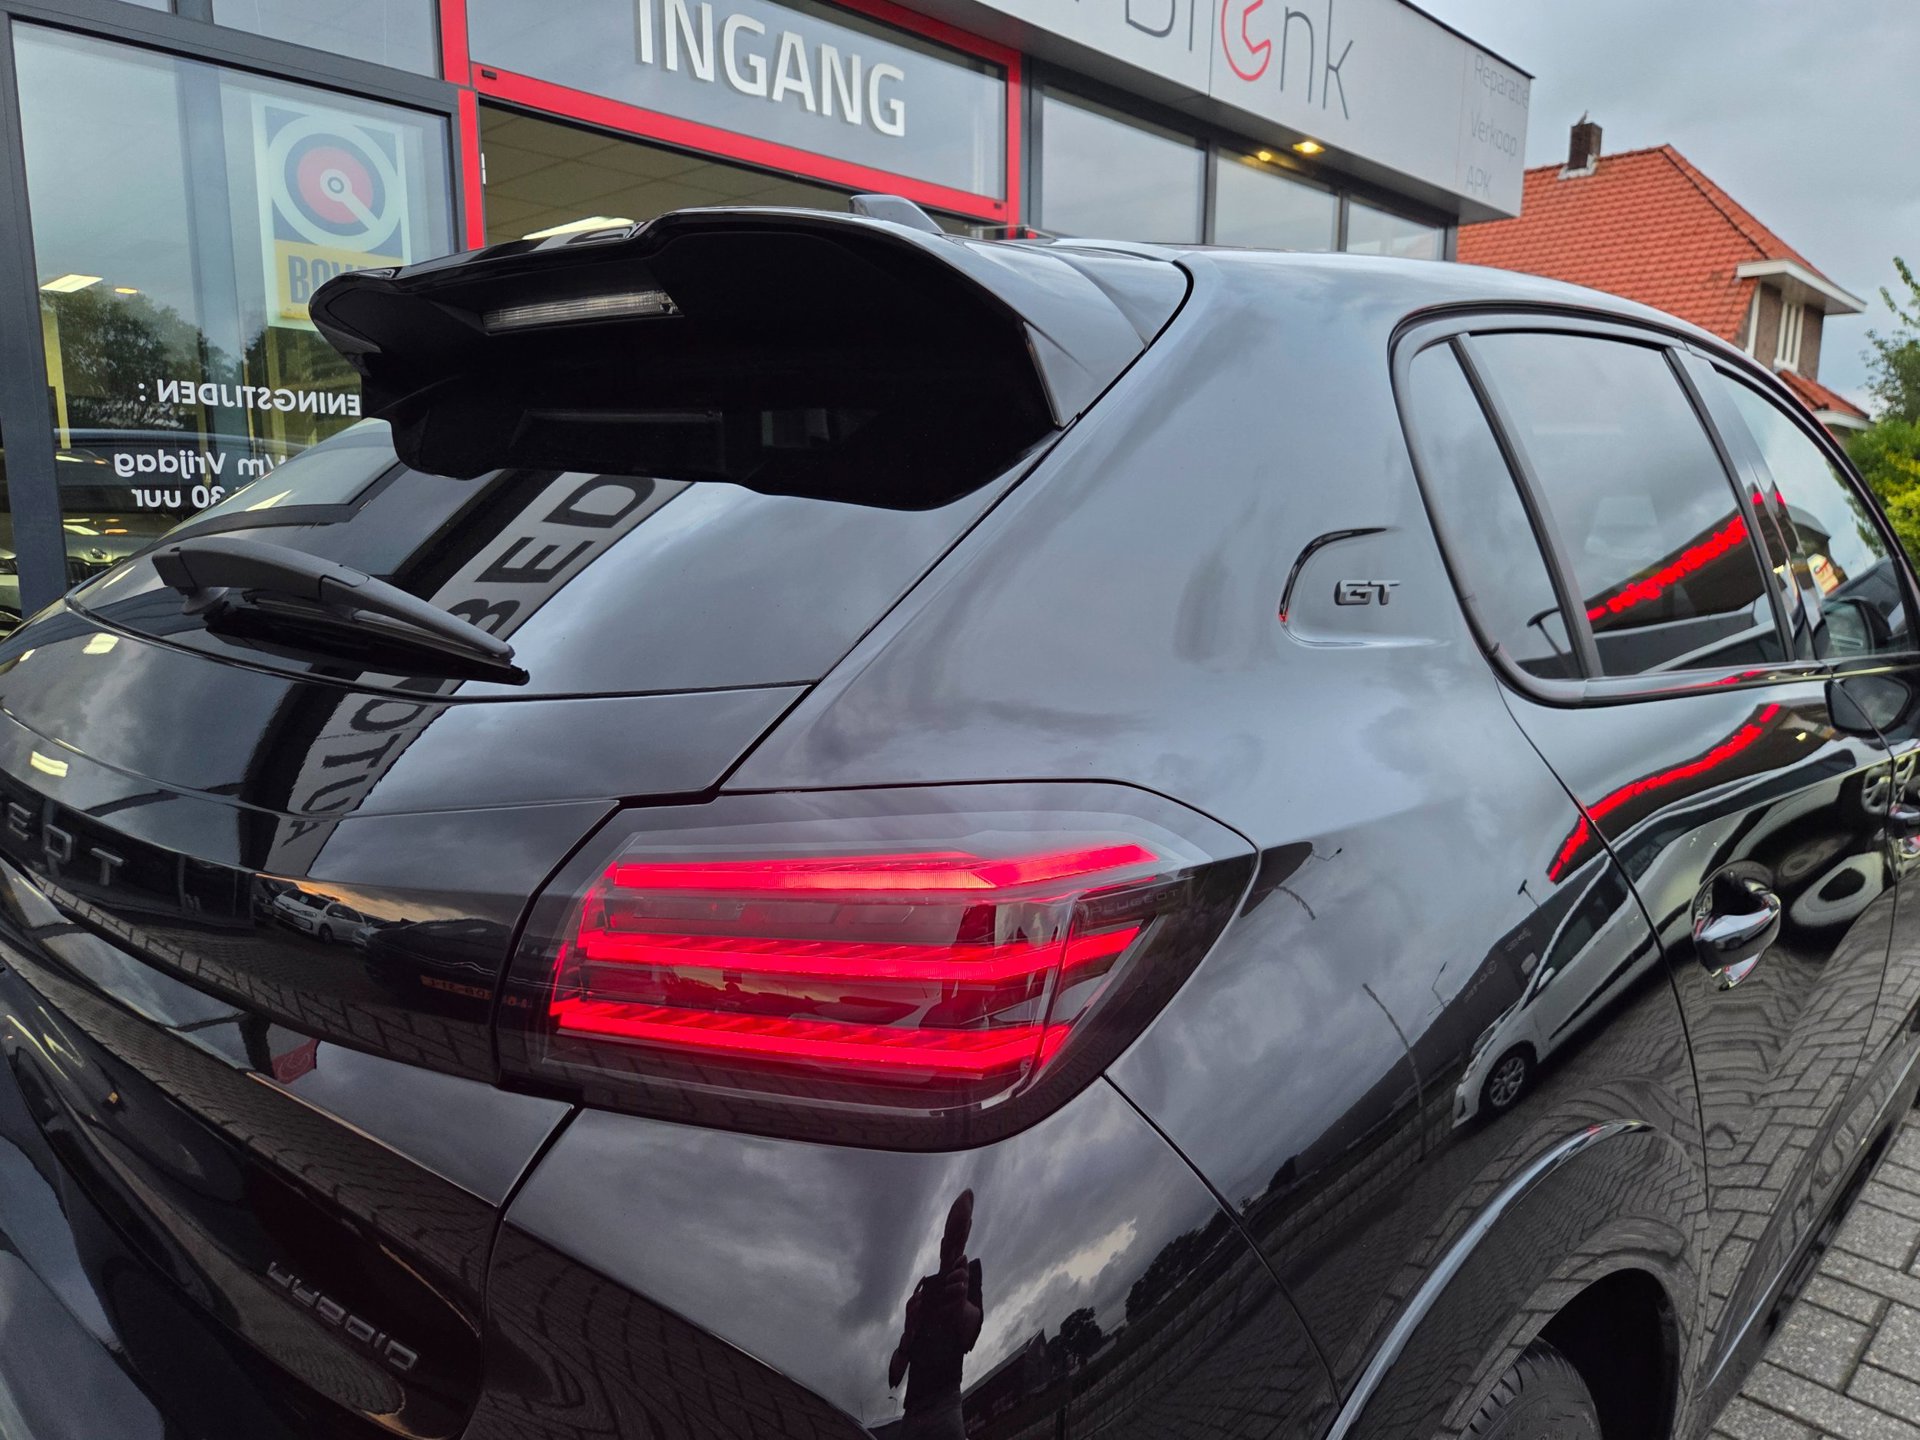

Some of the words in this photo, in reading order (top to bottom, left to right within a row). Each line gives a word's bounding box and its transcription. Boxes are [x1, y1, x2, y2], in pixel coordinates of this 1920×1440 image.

[635, 0, 905, 137] INGANG
[1471, 112, 1518, 161] Verkoop
[1466, 164, 1493, 198] APK
[1333, 579, 1401, 605] GT
[8, 802, 124, 887] EOT
[1089, 888, 1179, 914] PEUGEOT
